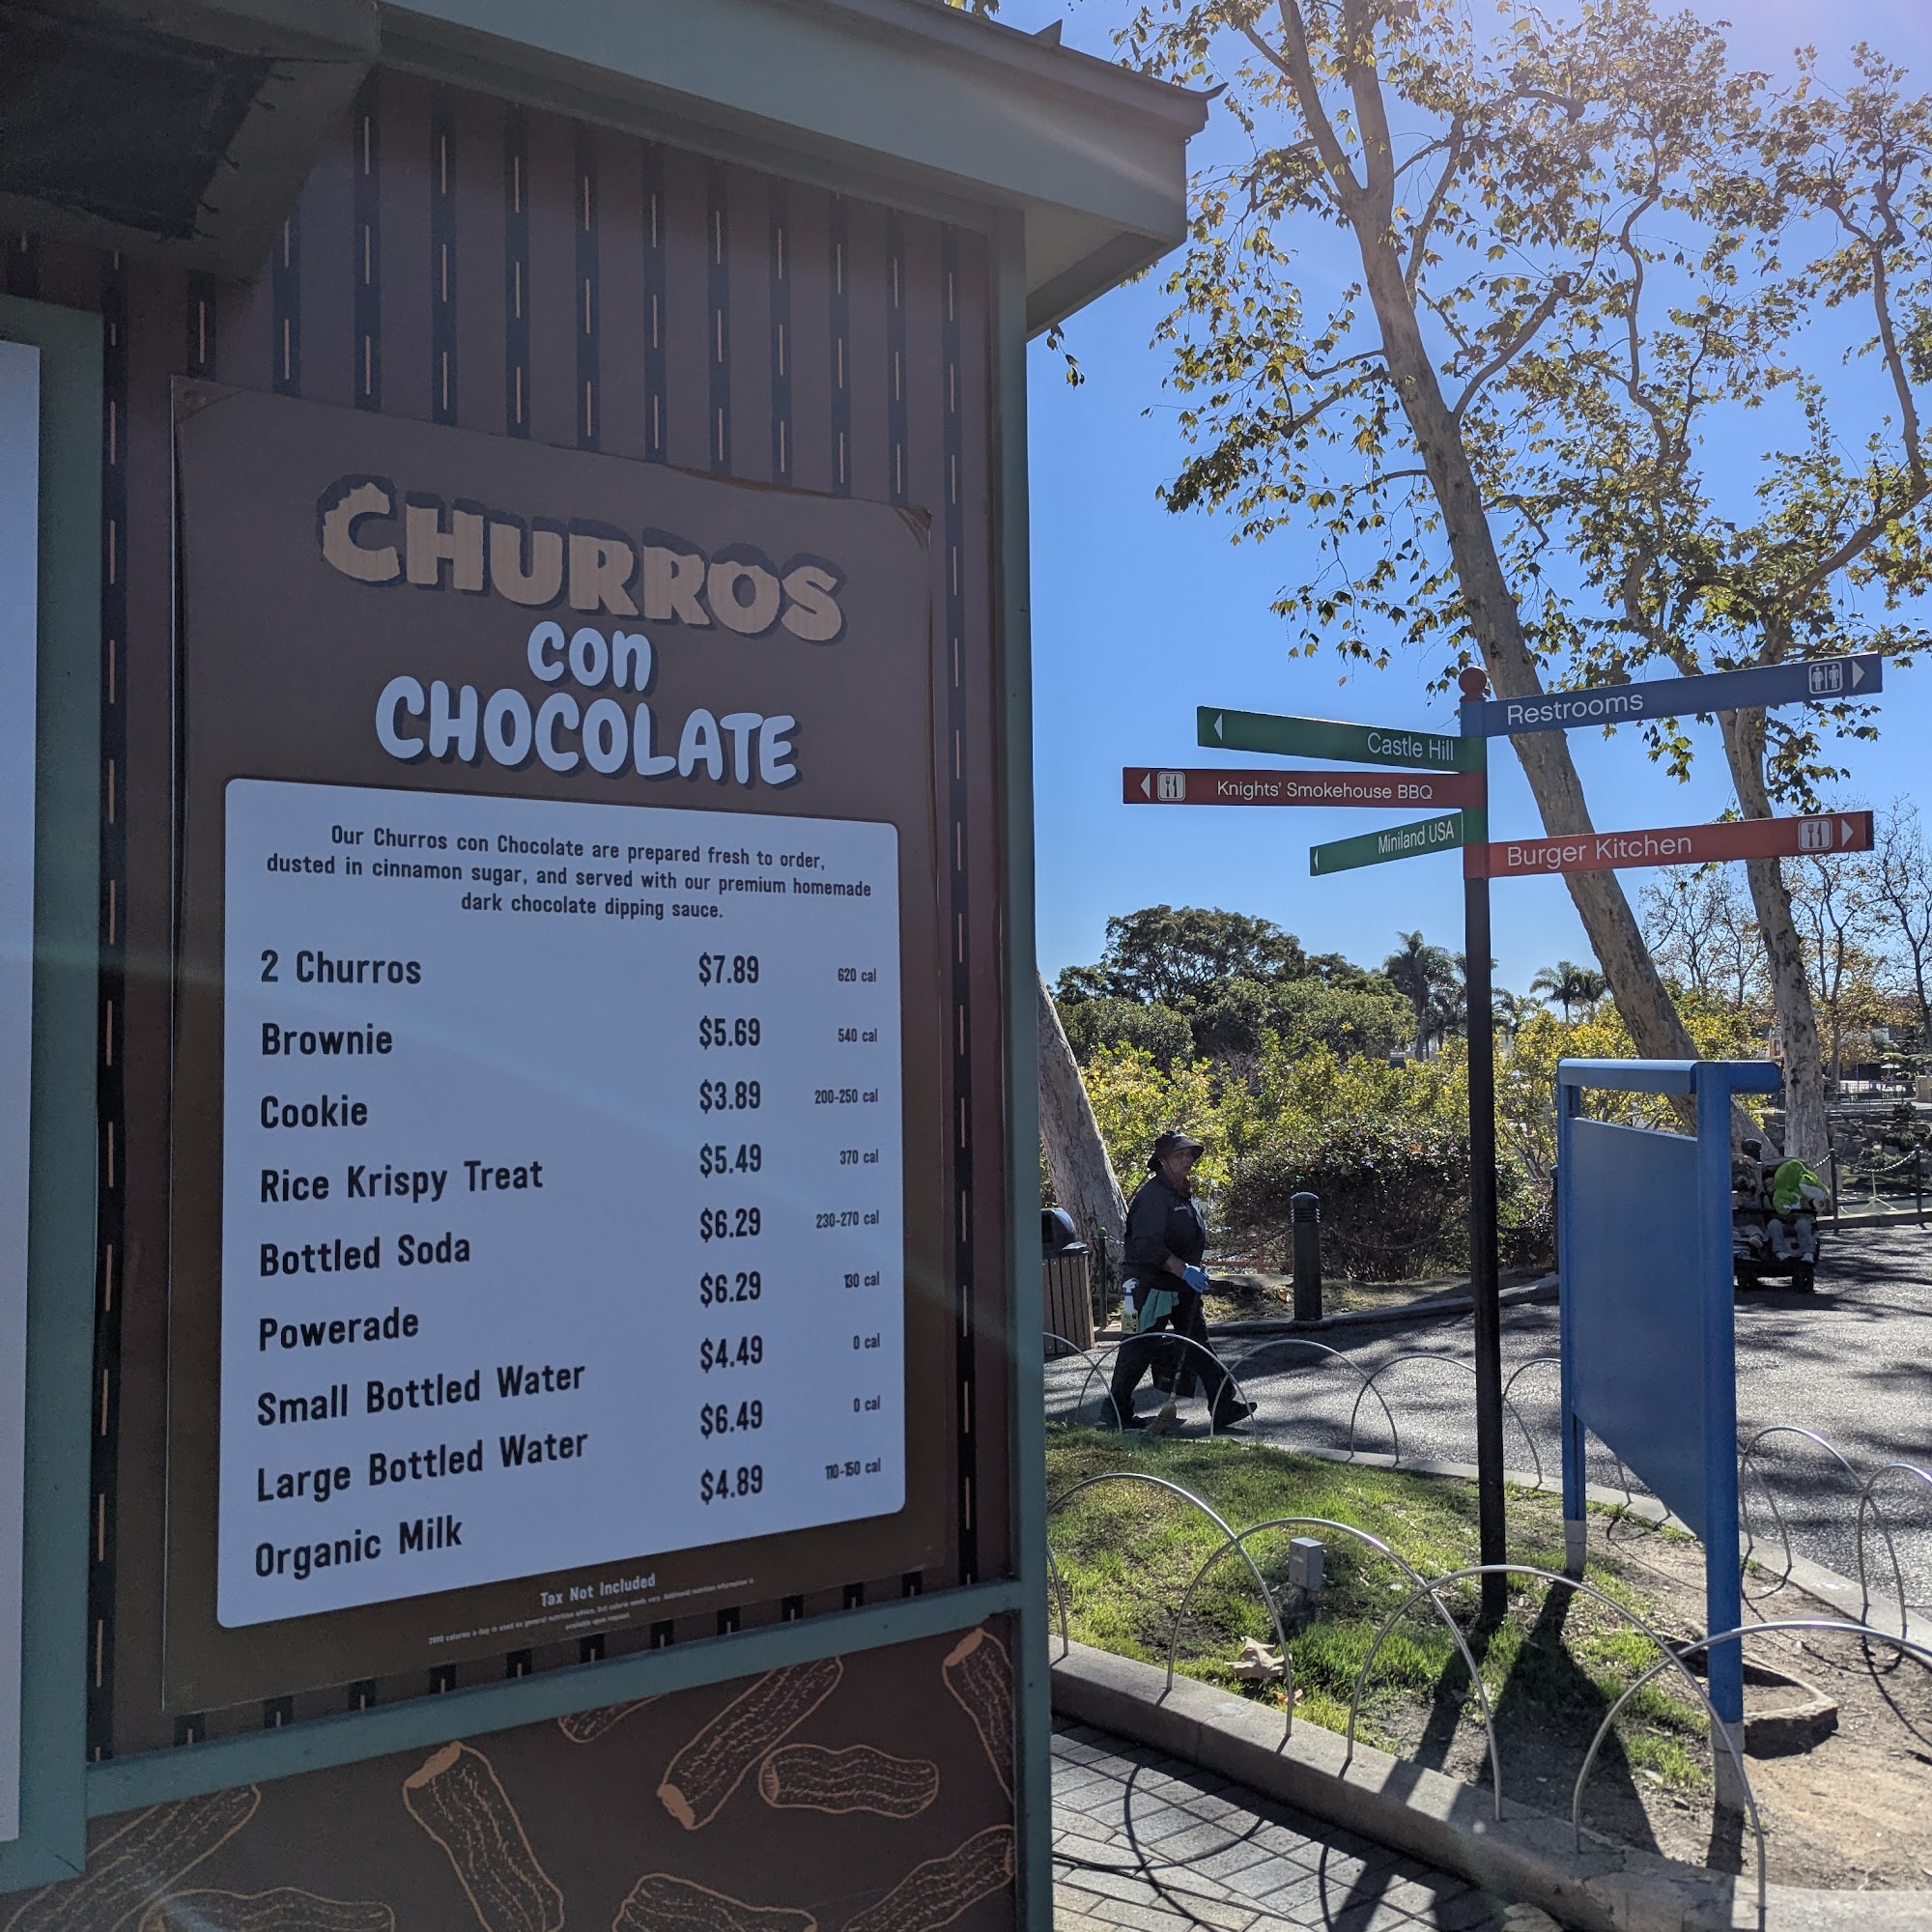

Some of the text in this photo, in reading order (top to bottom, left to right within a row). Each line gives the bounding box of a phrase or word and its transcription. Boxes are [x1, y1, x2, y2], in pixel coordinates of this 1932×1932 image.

[318, 474, 846, 645] CHURROS
[526, 620, 652, 692] con
[1507, 693, 1644, 726] Restrooms
[375, 671, 797, 785] CHOCOLATE
[1367, 731, 1454, 761] Castle Hill
[1217, 781, 1433, 801] Knights' Smokehouse BBQ
[331, 824, 825, 871] Our Churros con Chocolate are prepared fresh to order,
[1378, 820, 1455, 854] Miniland USA
[1507, 834, 1691, 869] Burger Kitchen
[267, 852, 871, 897] dusted in cinnamon sugar, and served with our premium homemade
[461, 892, 724, 921] dark chocolate dipping sauce.
[261, 949, 421, 984] 2 Churros
[698, 952, 759, 987] $7.89
[838, 967, 877, 982] 620 cal
[262, 1022, 392, 1056] Brownie
[698, 1014, 761, 1050] $5.69
[838, 1028, 878, 1043] 540 cal
[260, 1094, 368, 1129] Cookie
[699, 1078, 761, 1115] $3.89
[814, 1088, 878, 1105] 200-250 cal
[699, 1143, 762, 1179] $5.49
[839, 1149, 879, 1165] 370 cal
[261, 1160, 543, 1204] Rice Krispy Treat
[699, 1207, 761, 1243] $6.29
[815, 1208, 880, 1229] 230-270 cal
[260, 1232, 470, 1277] Bottled Soda
[699, 1270, 761, 1308] $6.29
[843, 1270, 880, 1289] 130 cal
[259, 1306, 419, 1351] Powerade
[853, 1332, 881, 1350] 0 cal
[700, 1334, 763, 1374] $4.49
[257, 1364, 585, 1427] Small Bottled Water
[853, 1394, 881, 1413] 0 cal
[700, 1400, 763, 1439] $6.49
[257, 1434, 588, 1503] Large Bottled Water
[700, 1464, 763, 1505] $4.89
[255, 1514, 463, 1580] Organic Milk
[539, 1591, 563, 1607] Tax
[569, 1585, 594, 1602] Not
[599, 1573, 656, 1597] Included
